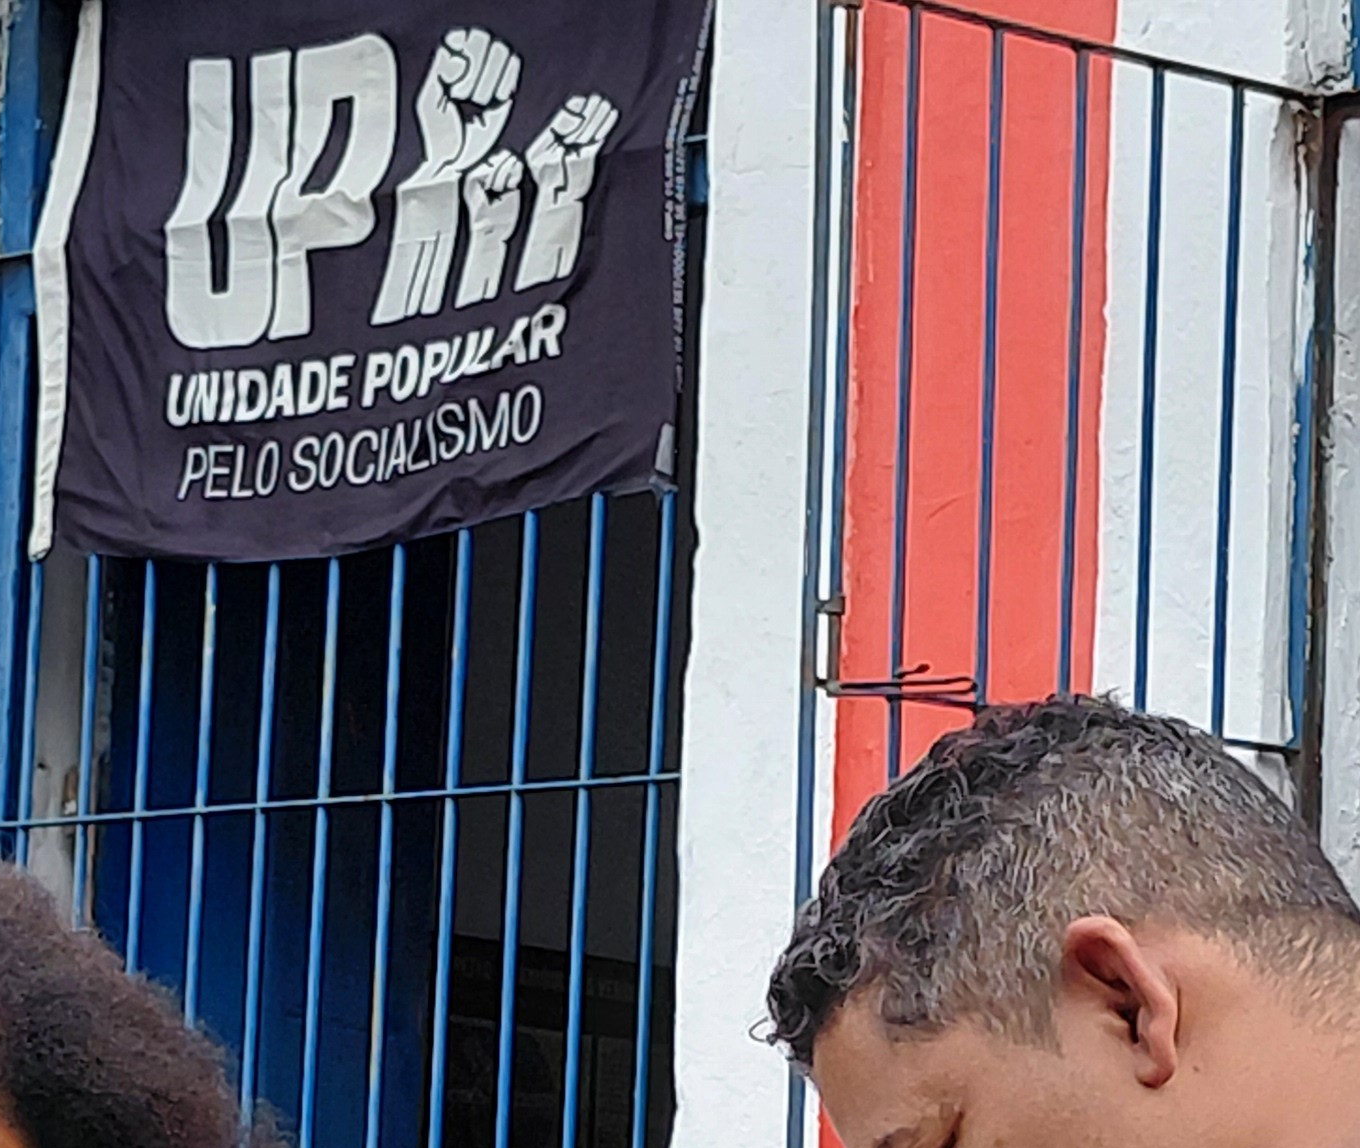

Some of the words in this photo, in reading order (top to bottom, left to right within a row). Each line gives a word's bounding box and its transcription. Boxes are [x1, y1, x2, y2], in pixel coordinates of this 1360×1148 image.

[165, 33, 396, 349] UP
[166, 355, 354, 427] UNIDADE
[360, 304, 567, 408] POPULAR
[178, 440, 280, 500] PELO
[287, 385, 543, 493] SOCIALISMO
